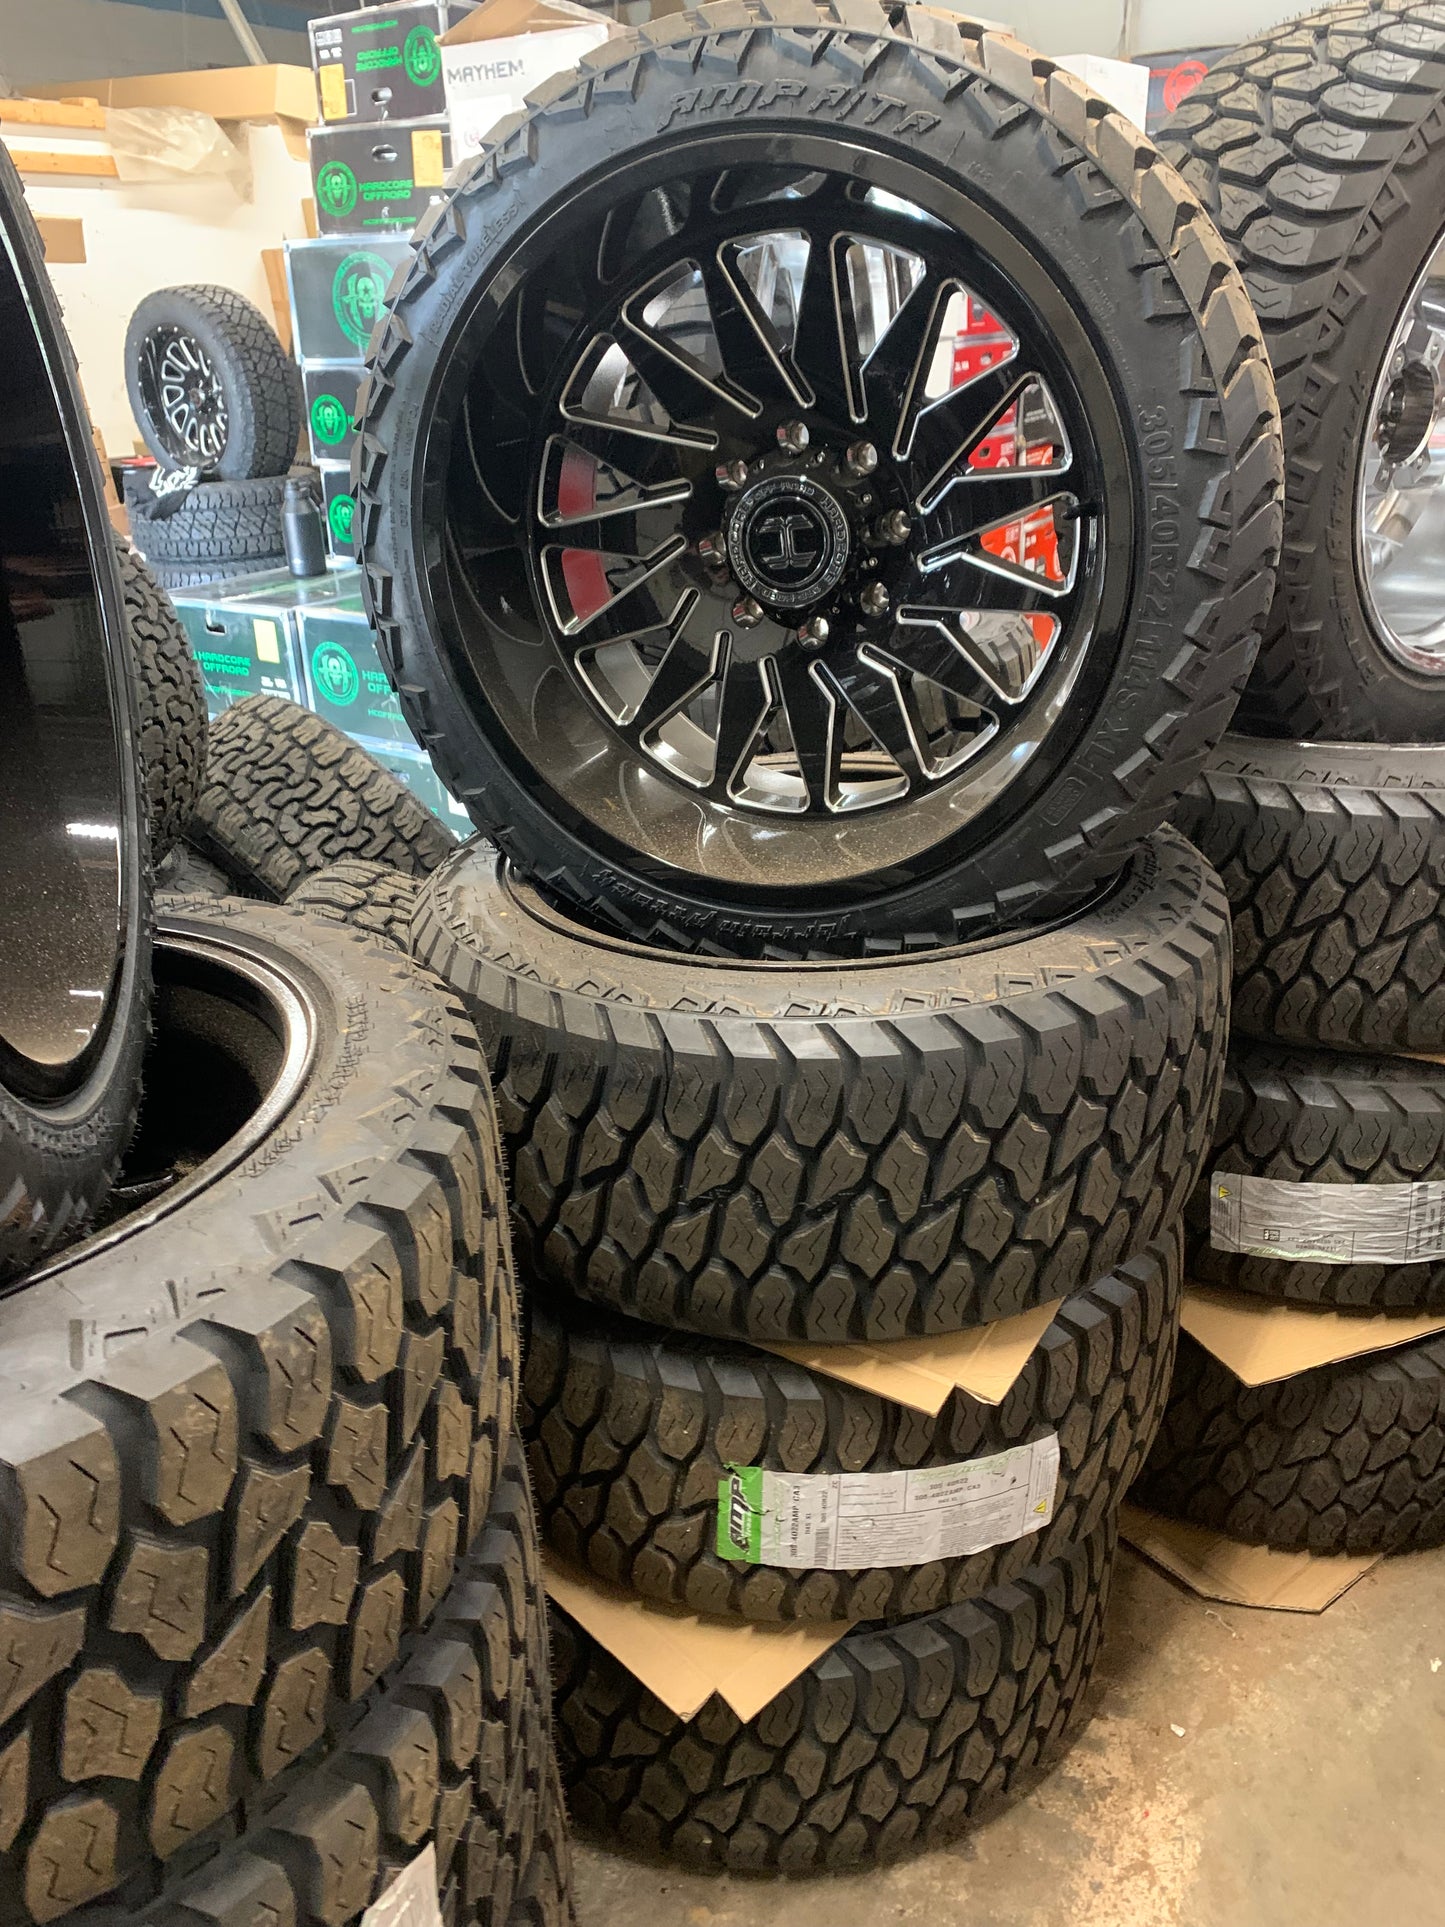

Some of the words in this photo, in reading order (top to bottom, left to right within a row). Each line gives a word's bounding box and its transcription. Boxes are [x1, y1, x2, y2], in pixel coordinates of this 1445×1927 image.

[462, 203, 519, 274] TUBELESS
[199, 651, 251, 666] HARDCORE
[203, 661, 250, 677] OFFROAD
